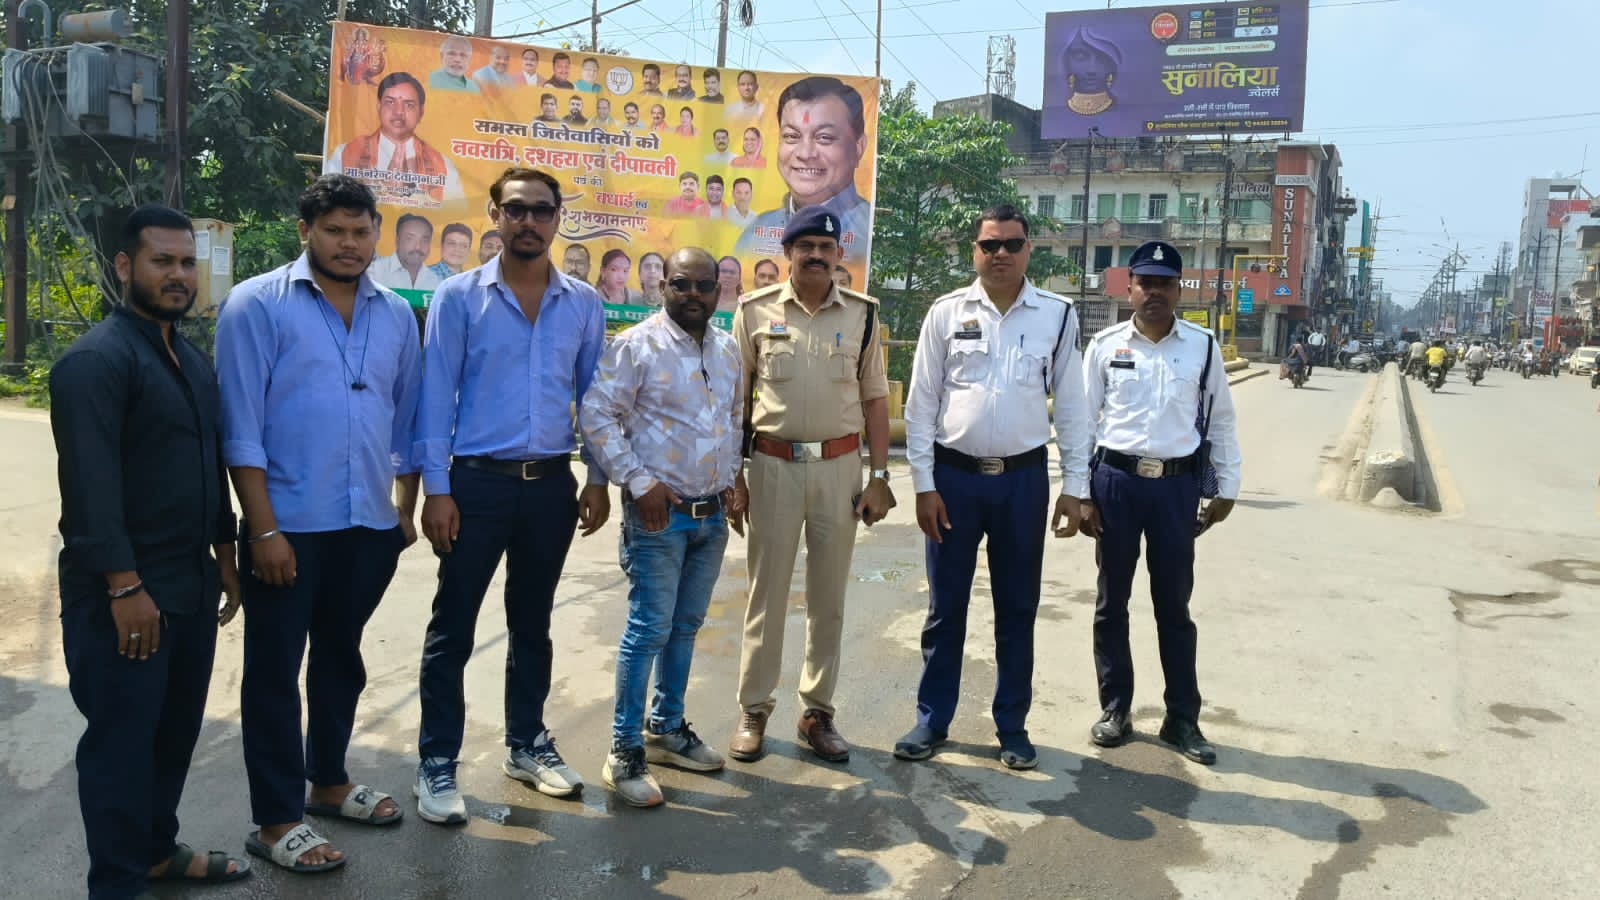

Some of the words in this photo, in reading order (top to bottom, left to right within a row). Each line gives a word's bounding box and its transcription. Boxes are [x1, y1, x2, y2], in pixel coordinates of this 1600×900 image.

[1161, 61, 1279, 95] सुनालिया
[1248, 85, 1280, 97] ज्वेलर्स
[474, 119, 528, 137] समस्त
[532, 121, 631, 147] जिलेवासियों
[636, 132, 660, 150] को
[452, 139, 520, 163] नवरात्रि,
[525, 147, 579, 168] दशहरा
[582, 147, 606, 171] एवं
[610, 151, 677, 177] दीपावली
[590, 175, 603, 187] की
[596, 191, 635, 208] बधाई
[1279, 188, 1295, 279] SUNALIYA
